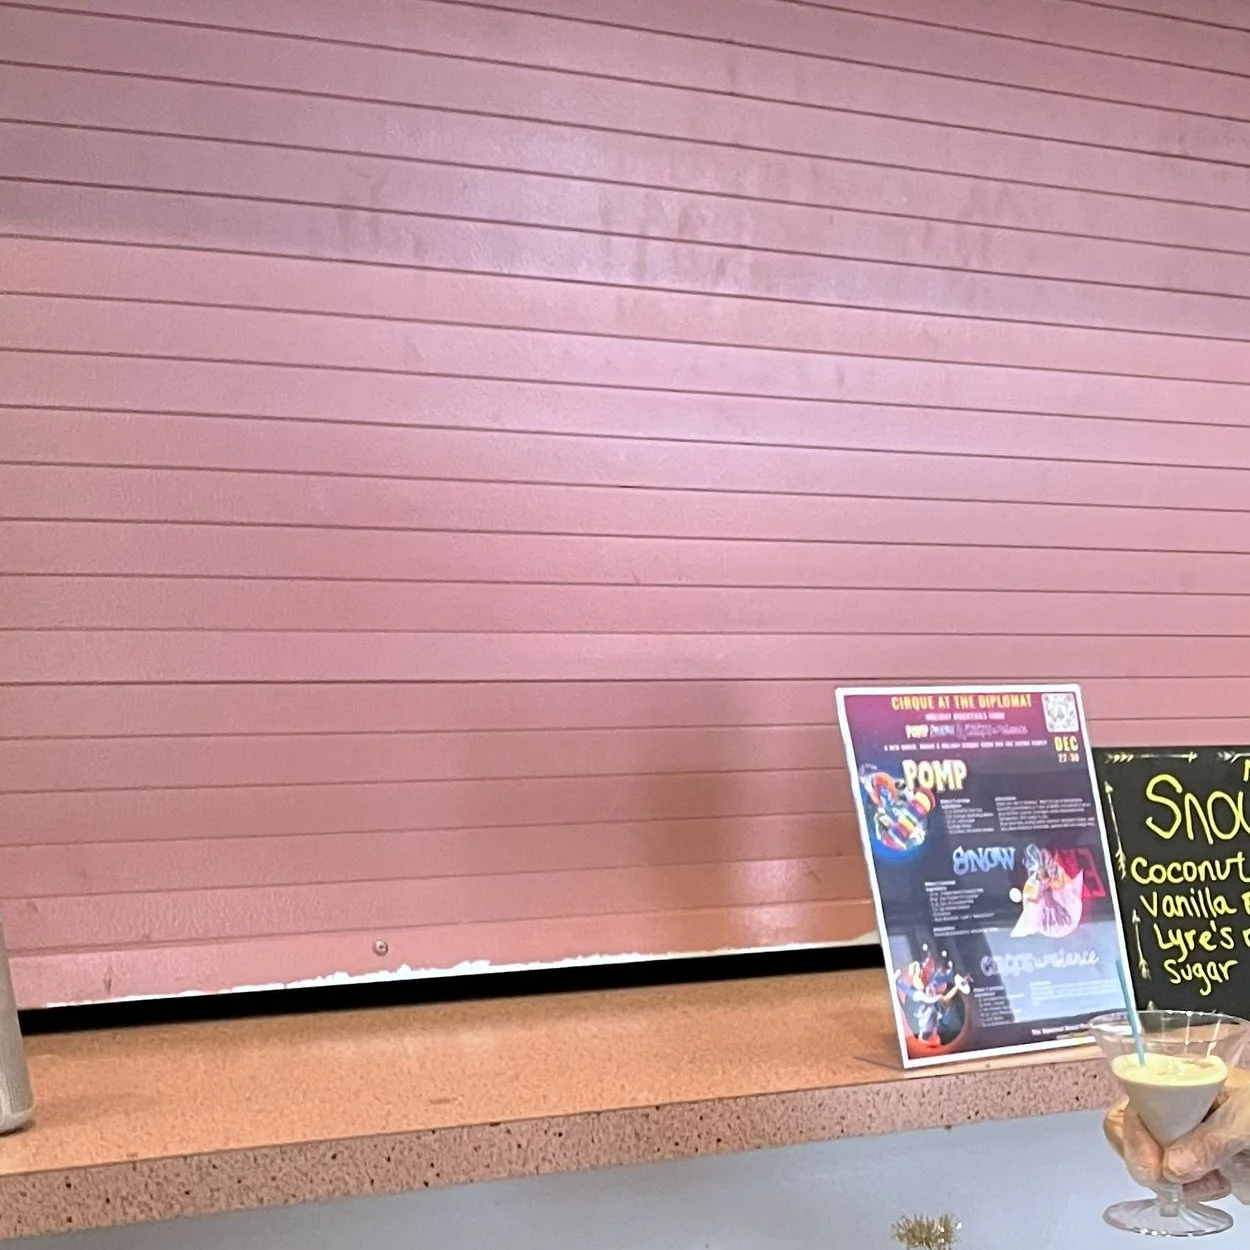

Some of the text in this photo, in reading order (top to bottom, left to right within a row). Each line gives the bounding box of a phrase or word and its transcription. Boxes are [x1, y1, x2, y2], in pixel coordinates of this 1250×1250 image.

[891, 694, 1032, 710] CIRQUE AT THE DIPLOMAT
[1054, 736, 1079, 752] DEC
[902, 759, 967, 792] POMP
[952, 846, 1016, 876] SNOW
[1140, 887, 1237, 919] Vanilla
[1152, 920, 1235, 962] Lyre's
